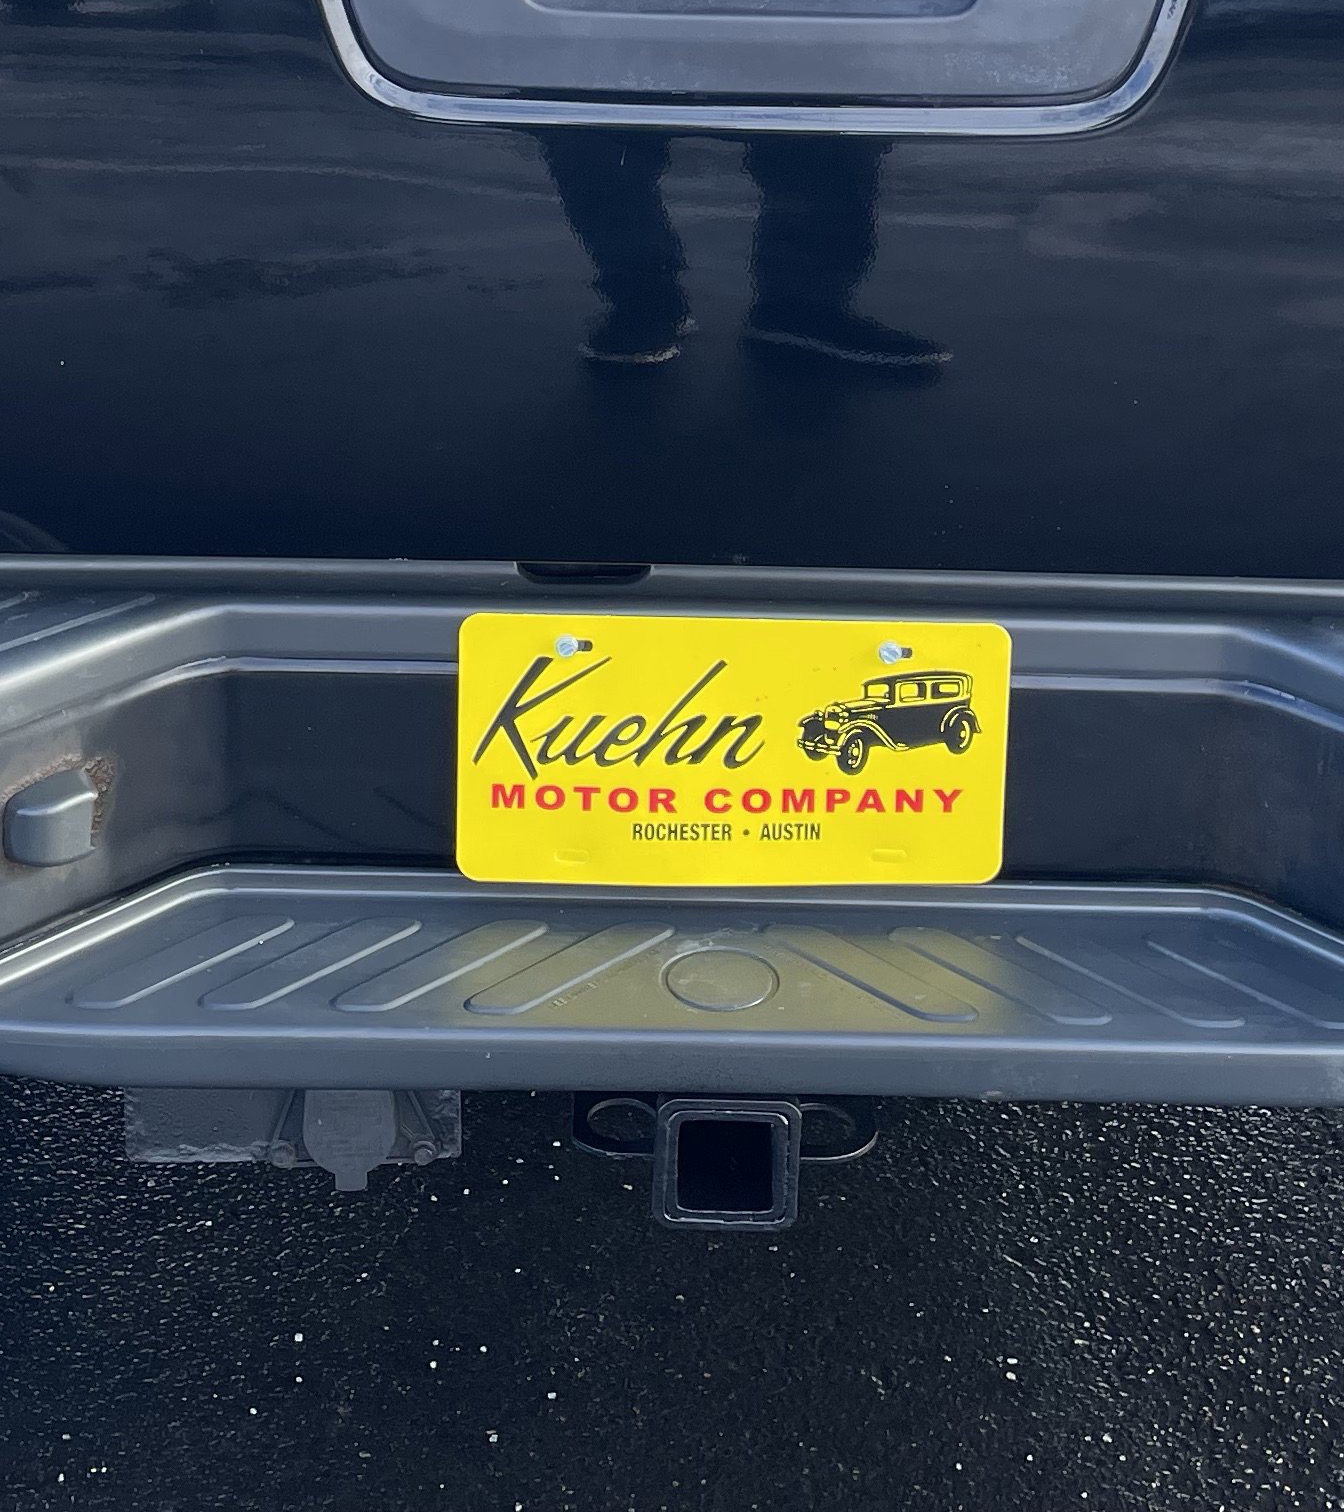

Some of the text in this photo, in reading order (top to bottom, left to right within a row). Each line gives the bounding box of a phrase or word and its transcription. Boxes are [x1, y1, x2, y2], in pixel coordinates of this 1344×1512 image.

[473, 656, 765, 780] Kuehn
[491, 783, 964, 814] MOTOR COMPANY
[632, 823, 821, 841] ROCHESTER AUSTIN
